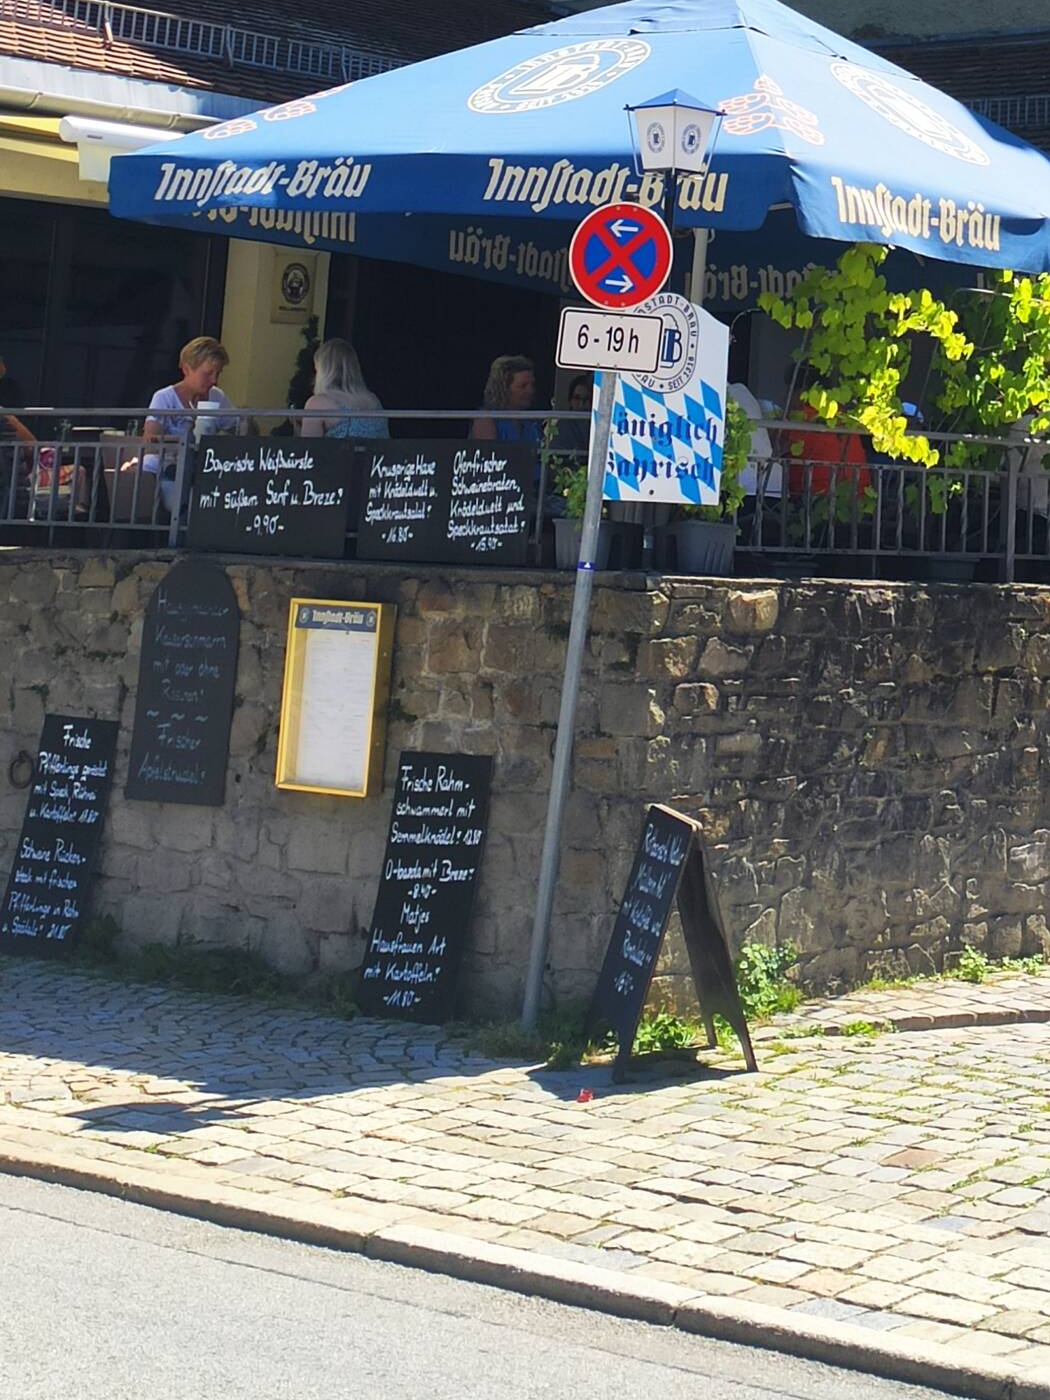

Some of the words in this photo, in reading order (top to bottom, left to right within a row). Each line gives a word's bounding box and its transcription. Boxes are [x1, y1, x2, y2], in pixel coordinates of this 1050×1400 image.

[577, 324, 589, 350] 6
[606, 325, 625, 353] 19
[628, 328, 639, 354] h
[617, 411, 717, 447] öniglich
[203, 448, 254, 479] Bayerische
[200, 486, 221, 509] mit
[265, 479, 291, 506] Senf
[401, 765, 433, 792] Frische
[456, 797, 476, 819] mit
[400, 901, 430, 934] Matjes
[427, 934, 447, 956] Art
[363, 961, 382, 980] mit
